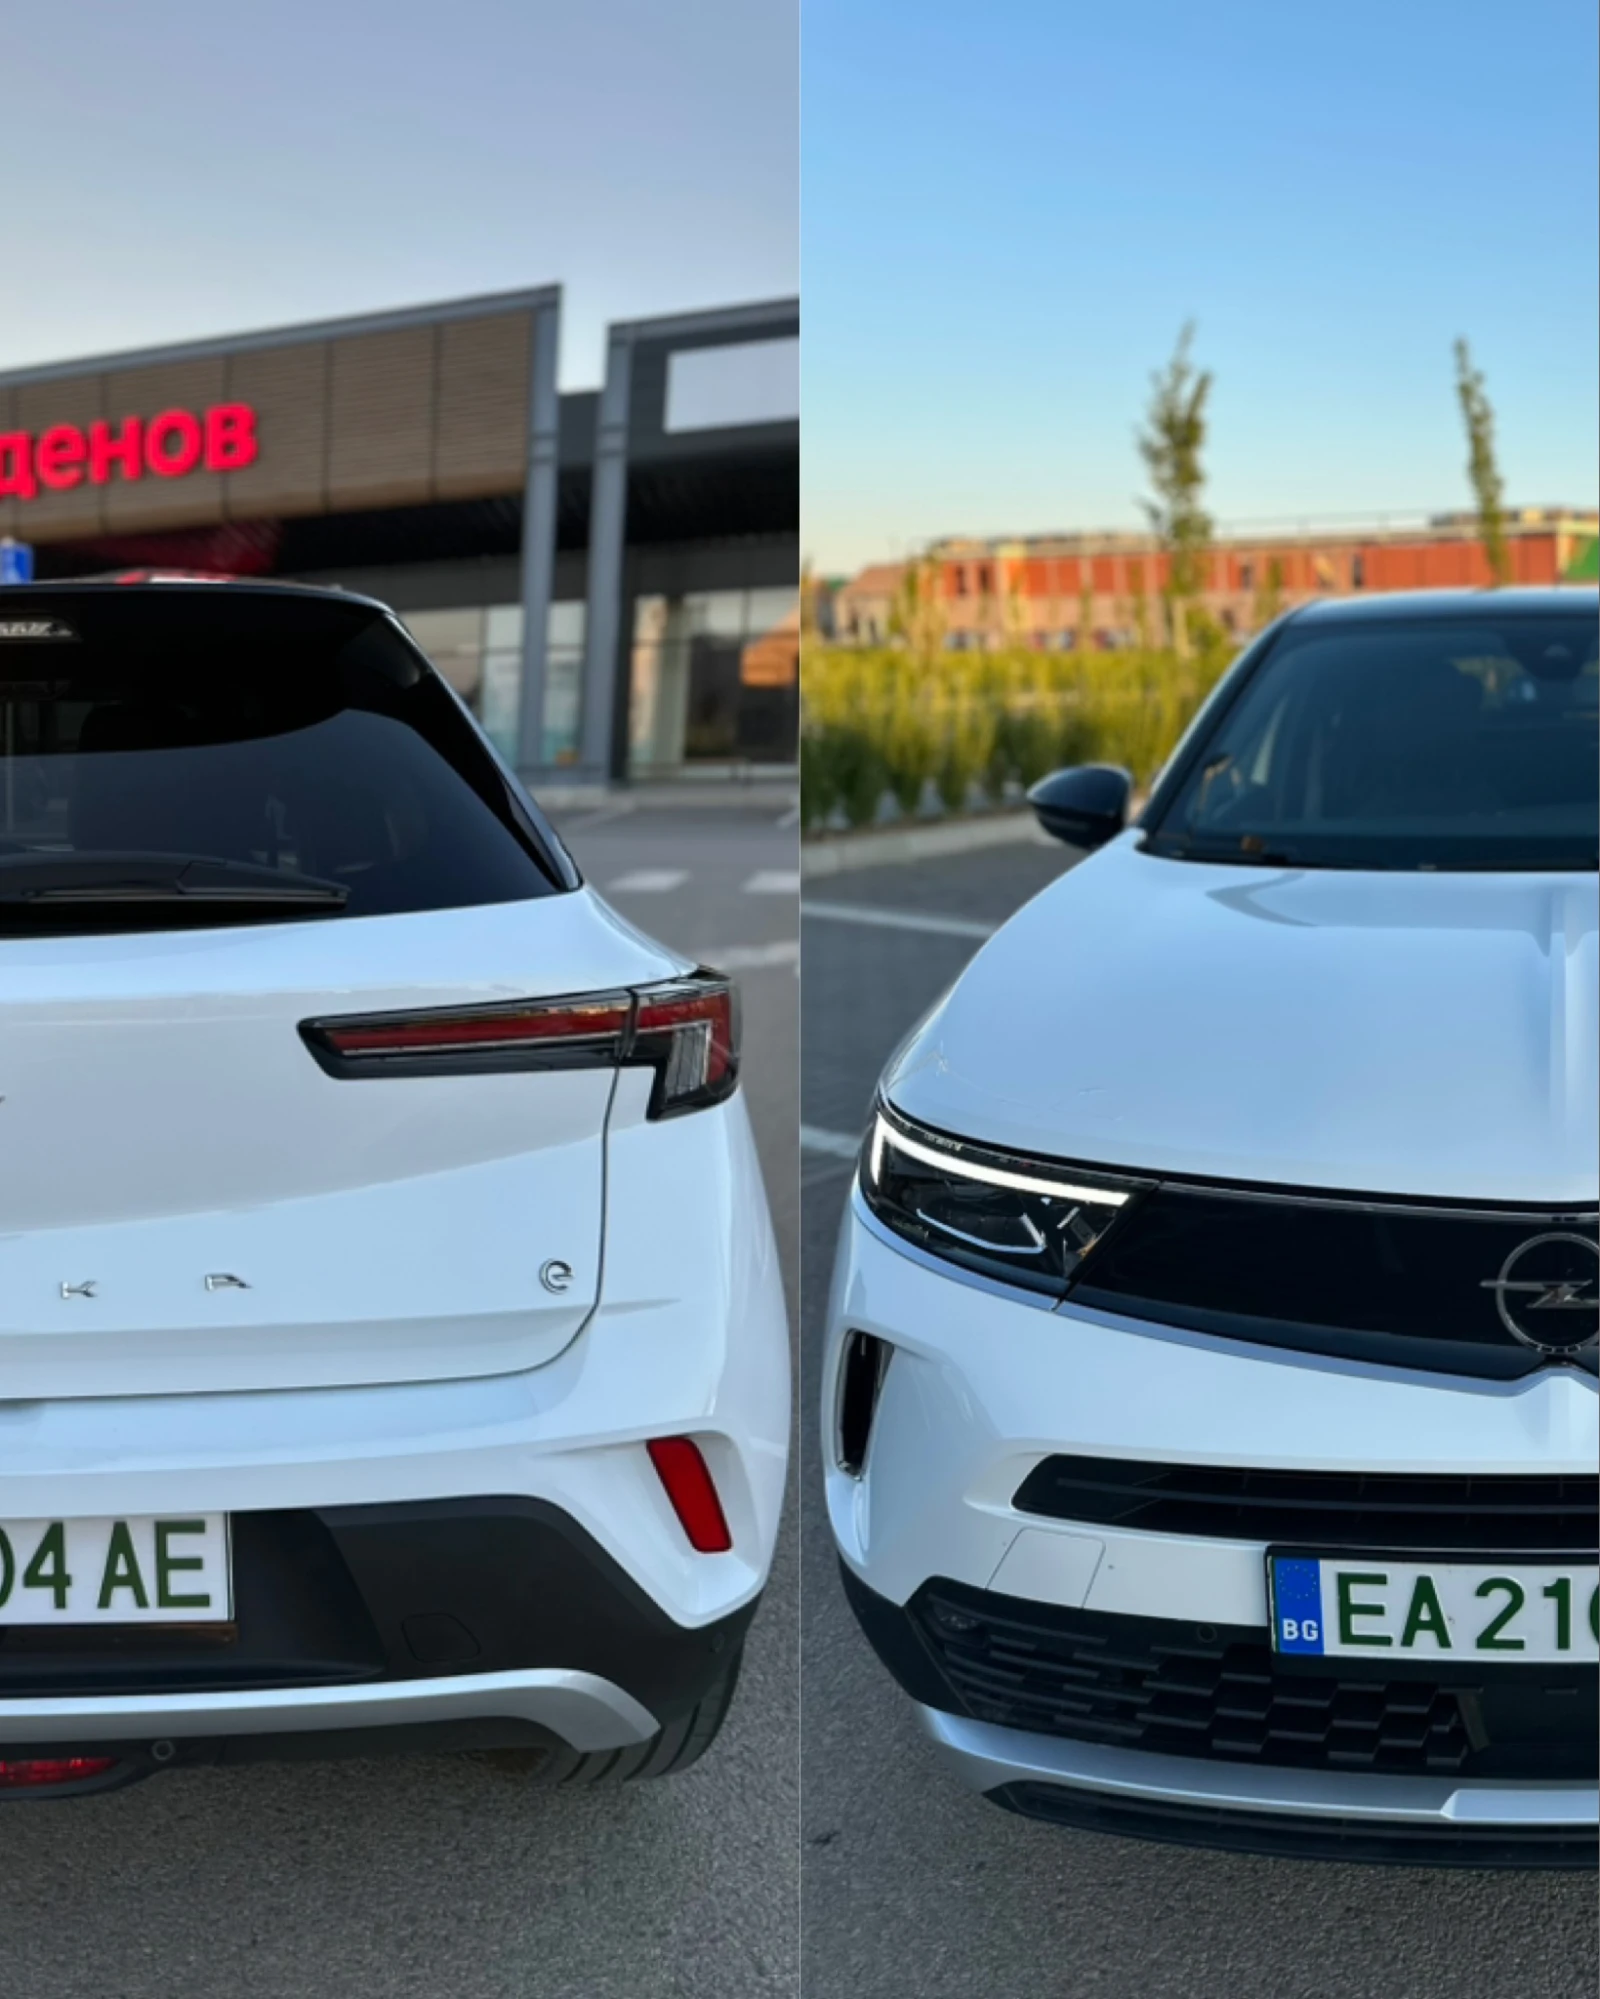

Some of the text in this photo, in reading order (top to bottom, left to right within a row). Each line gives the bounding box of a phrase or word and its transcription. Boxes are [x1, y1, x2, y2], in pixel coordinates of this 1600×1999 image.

[97, 1519, 211, 1609] AE
[1282, 1618, 1319, 1641] BG
[1336, 1571, 1599, 1650] EA 21
